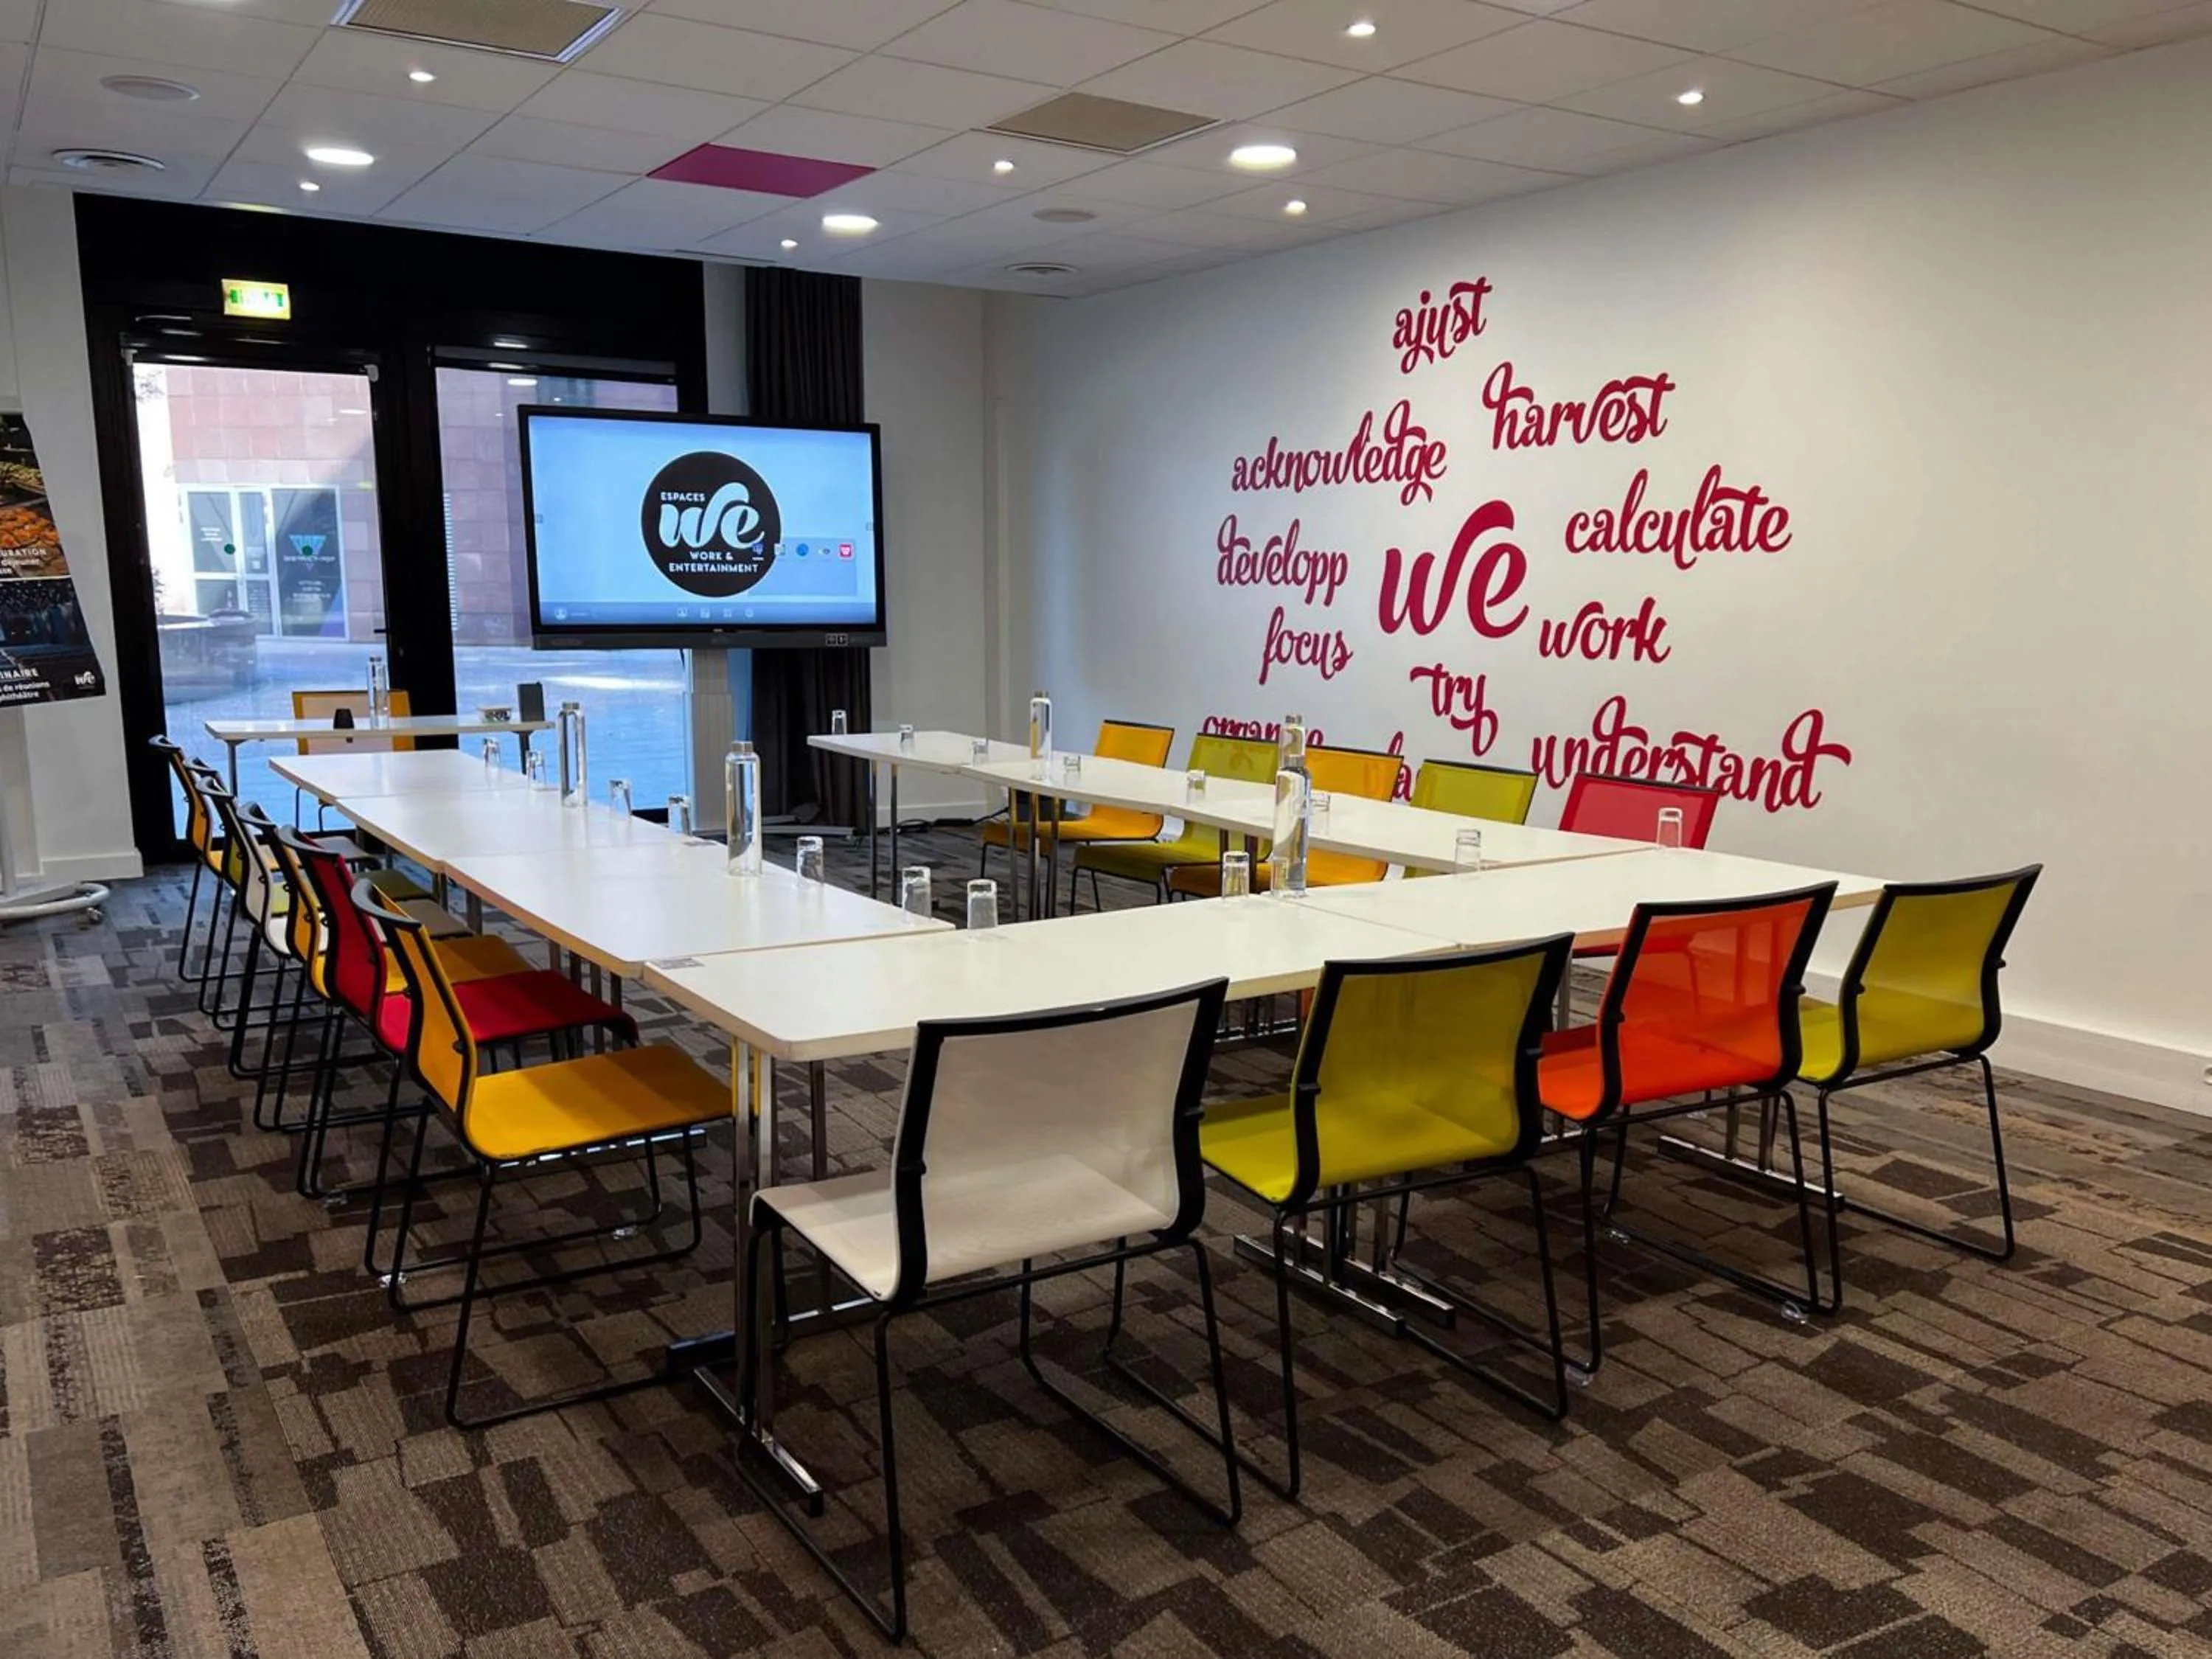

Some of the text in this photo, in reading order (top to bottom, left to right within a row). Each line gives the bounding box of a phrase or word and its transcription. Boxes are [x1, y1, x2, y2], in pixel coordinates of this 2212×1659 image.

[1392, 276, 1492, 374] ajust
[1482, 362, 1676, 449] harvest
[661, 492, 706, 502] ESPACES
[1231, 400, 1447, 505] acknowledge
[689, 551, 723, 561] WORK
[1217, 514, 1349, 606] developp
[1565, 465, 1792, 570] calculate
[669, 563, 759, 573] ENTERTAINMENT
[1259, 606, 1354, 684] focus
[1539, 597, 1672, 664] work
[1409, 663, 1499, 757] try
[1531, 695, 1852, 813] understand
